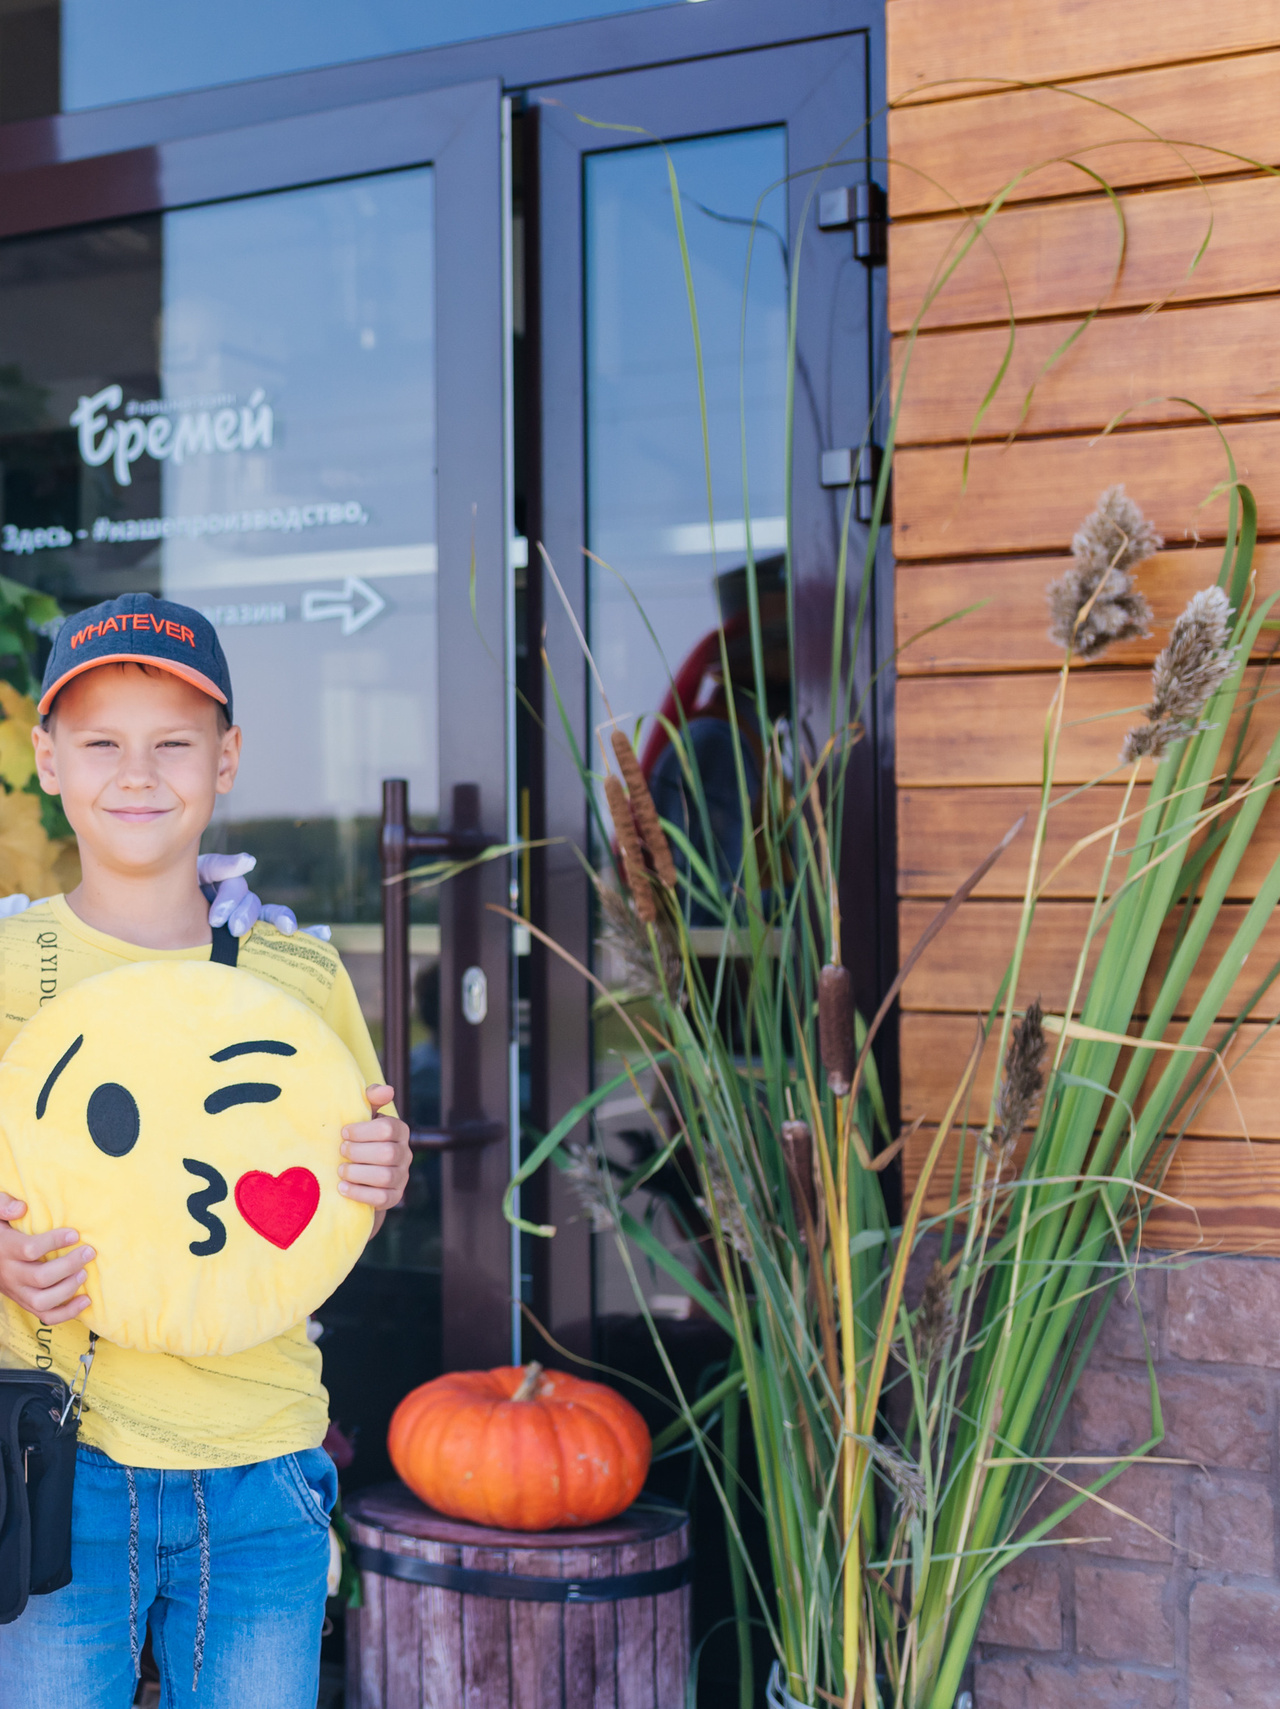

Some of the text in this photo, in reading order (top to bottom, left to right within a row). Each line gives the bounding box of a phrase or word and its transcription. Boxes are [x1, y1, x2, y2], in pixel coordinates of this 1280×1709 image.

[69, 383, 274, 487] Еремей
[1, 524, 73, 555] Здесь
[92, 501, 369, 543] #нашепроизводство,
[71, 614, 196, 649] WHATEVER
[37, 932, 57, 949] QI
[41, 954, 57, 972] YI
